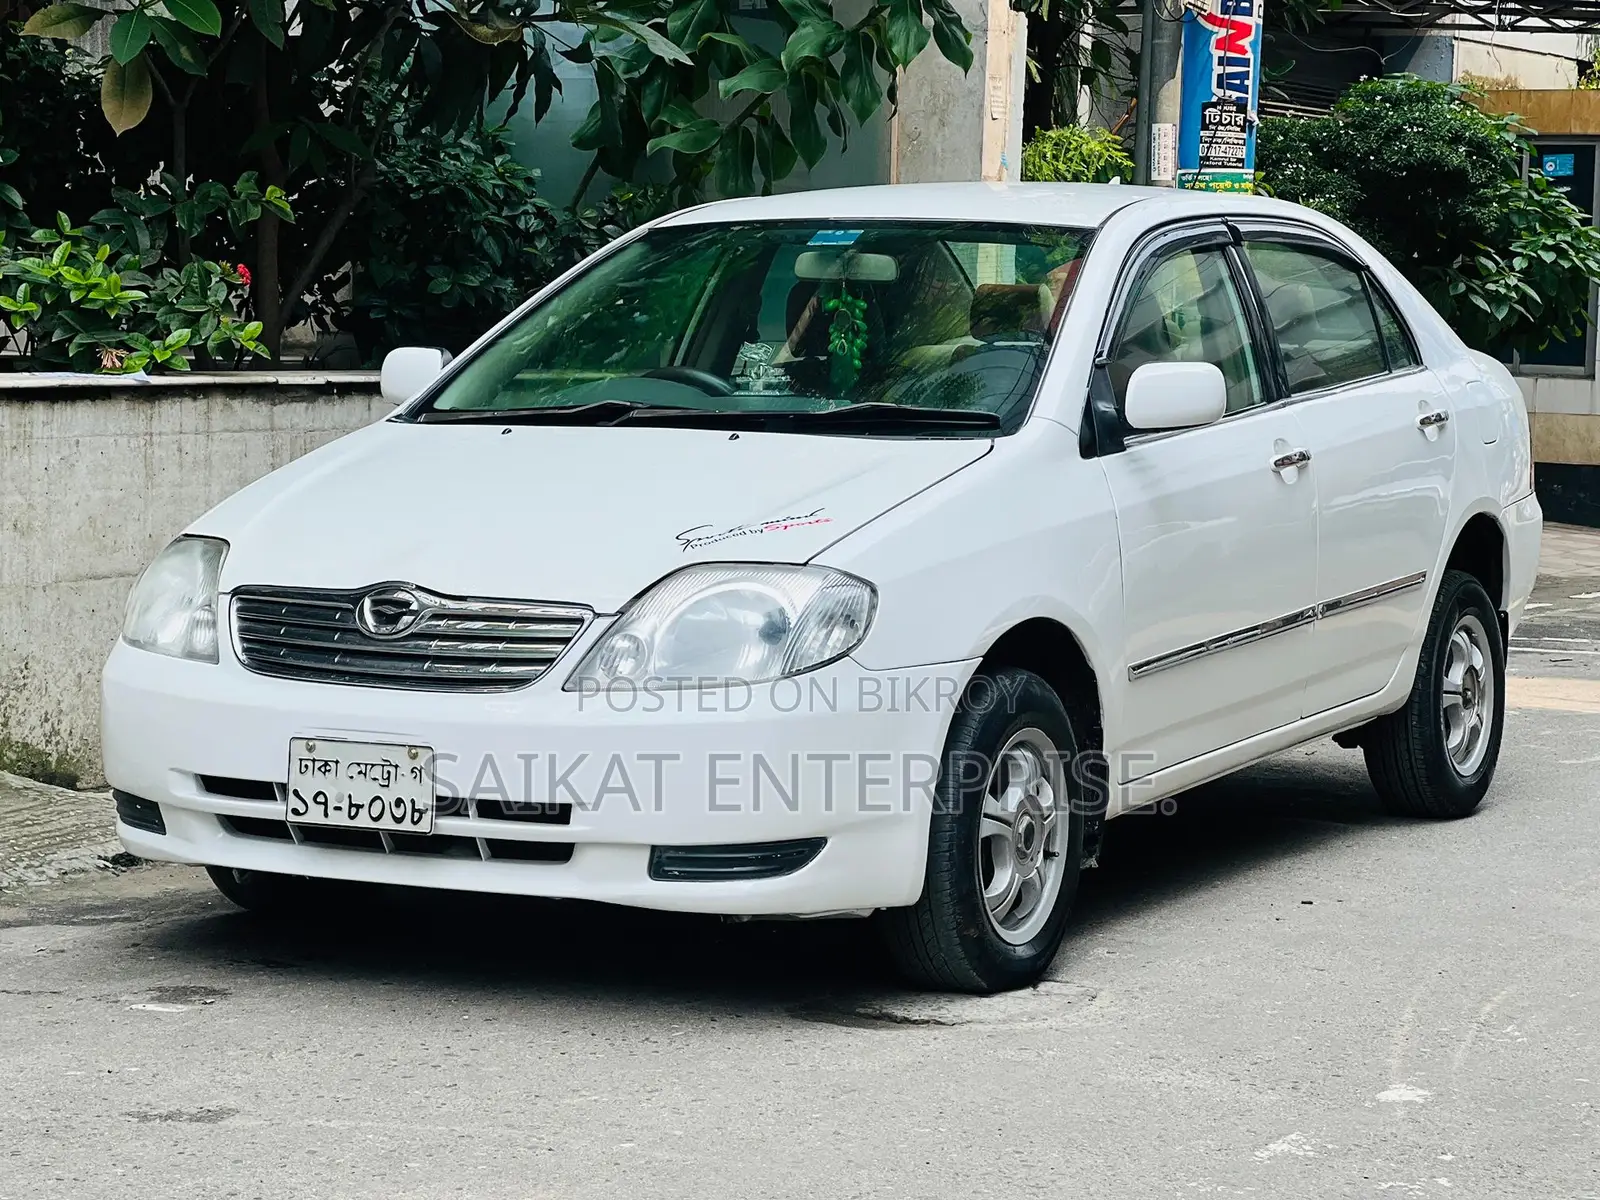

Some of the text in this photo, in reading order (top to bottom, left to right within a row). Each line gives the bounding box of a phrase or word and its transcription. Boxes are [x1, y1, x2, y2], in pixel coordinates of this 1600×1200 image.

[1203, 107, 1246, 126] টিচার
[690, 517, 834, 550] Produced by Sports
[298, 757, 340, 778] ঢাকা
[290, 788, 429, 826] ১৭-৮০৩৮
